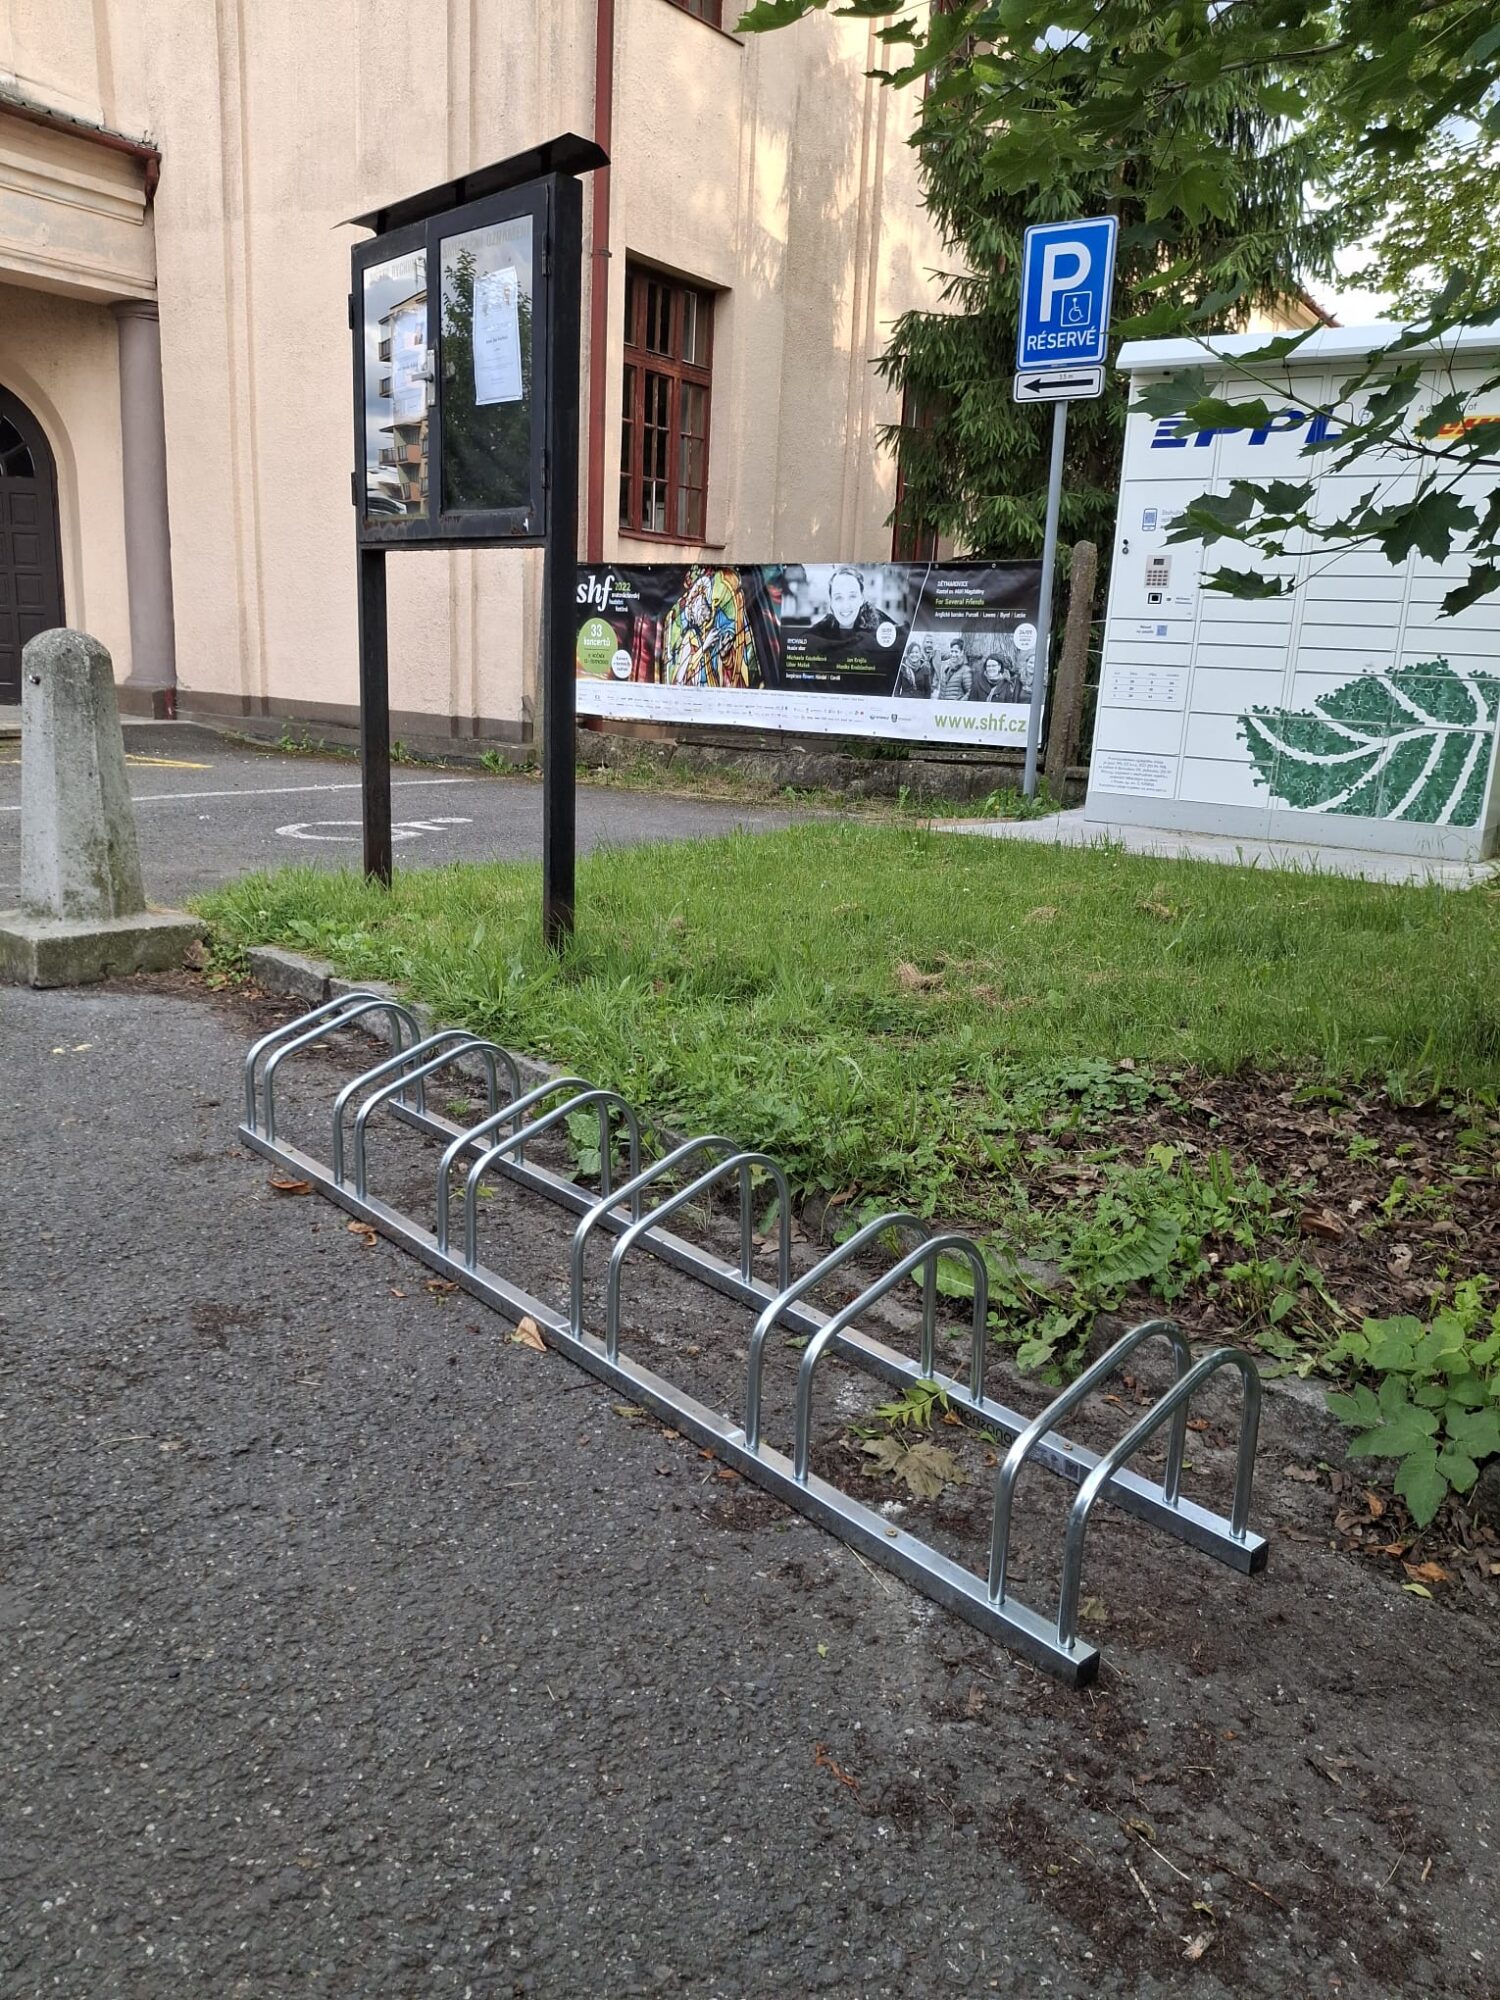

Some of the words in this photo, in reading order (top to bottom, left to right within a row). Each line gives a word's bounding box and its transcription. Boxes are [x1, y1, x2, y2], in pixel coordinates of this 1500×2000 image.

[1039, 241, 1091, 322] P
[1027, 326, 1096, 350] RÉSERVÉ
[1468, 402, 1478, 411] of
[576, 575, 615, 612] shf
[615, 582, 631, 591] 2022
[590, 623, 603, 637] 33
[935, 713, 1027, 733] www.shf.cz
